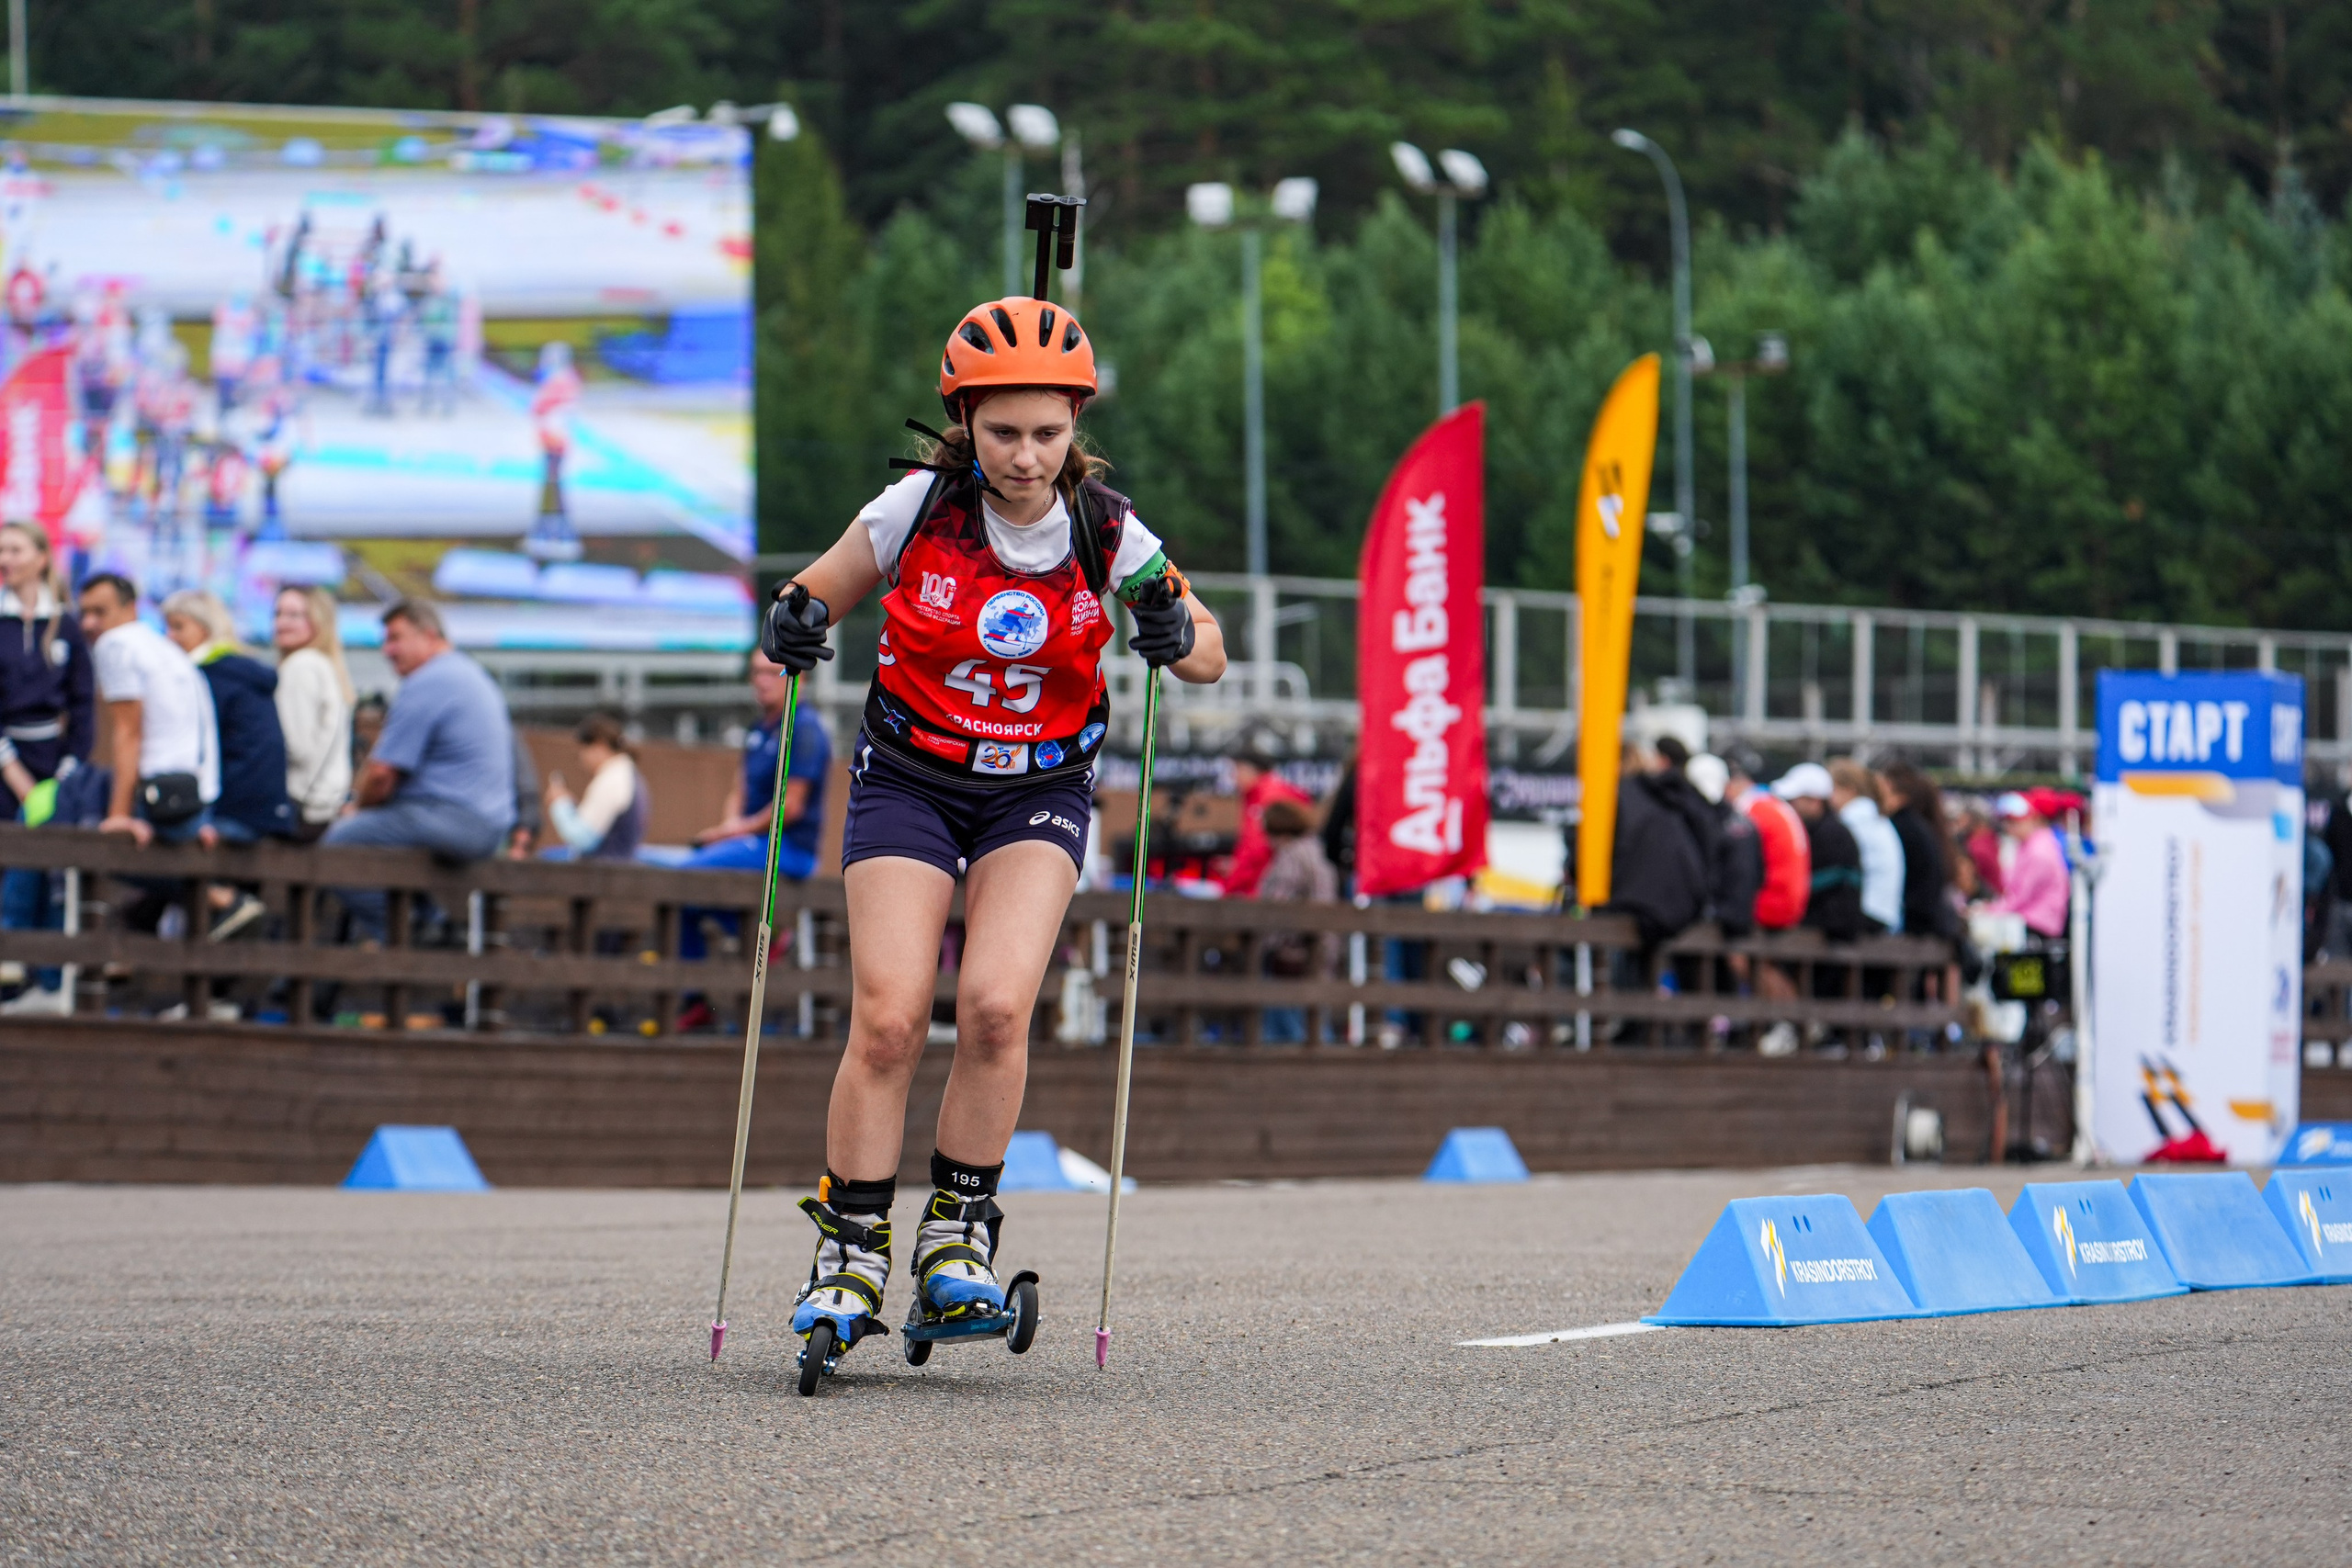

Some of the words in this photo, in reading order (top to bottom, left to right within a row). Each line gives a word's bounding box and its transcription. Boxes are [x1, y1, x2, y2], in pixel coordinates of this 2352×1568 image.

[1392, 491, 1449, 653] Банк
[986, 591, 1025, 608] ПЕРВЕНСТВО
[1025, 595, 1046, 617] РОССИИ
[1071, 607, 1100, 626] ЖИЗНИ
[944, 658, 1053, 714] 45
[945, 713, 1044, 737] КРАСНОЯРСК
[2117, 699, 2250, 763] СТАРТ
[1389, 653, 1462, 854] Альфа
[1051, 814, 1080, 838] asics
[951, 1171, 980, 1188] 195
[810, 1211, 840, 1235] FISCHER
[2078, 1238, 2148, 1264] KRASINDORSTROY
[1790, 1258, 1879, 1283] KRASINDORSTROY
